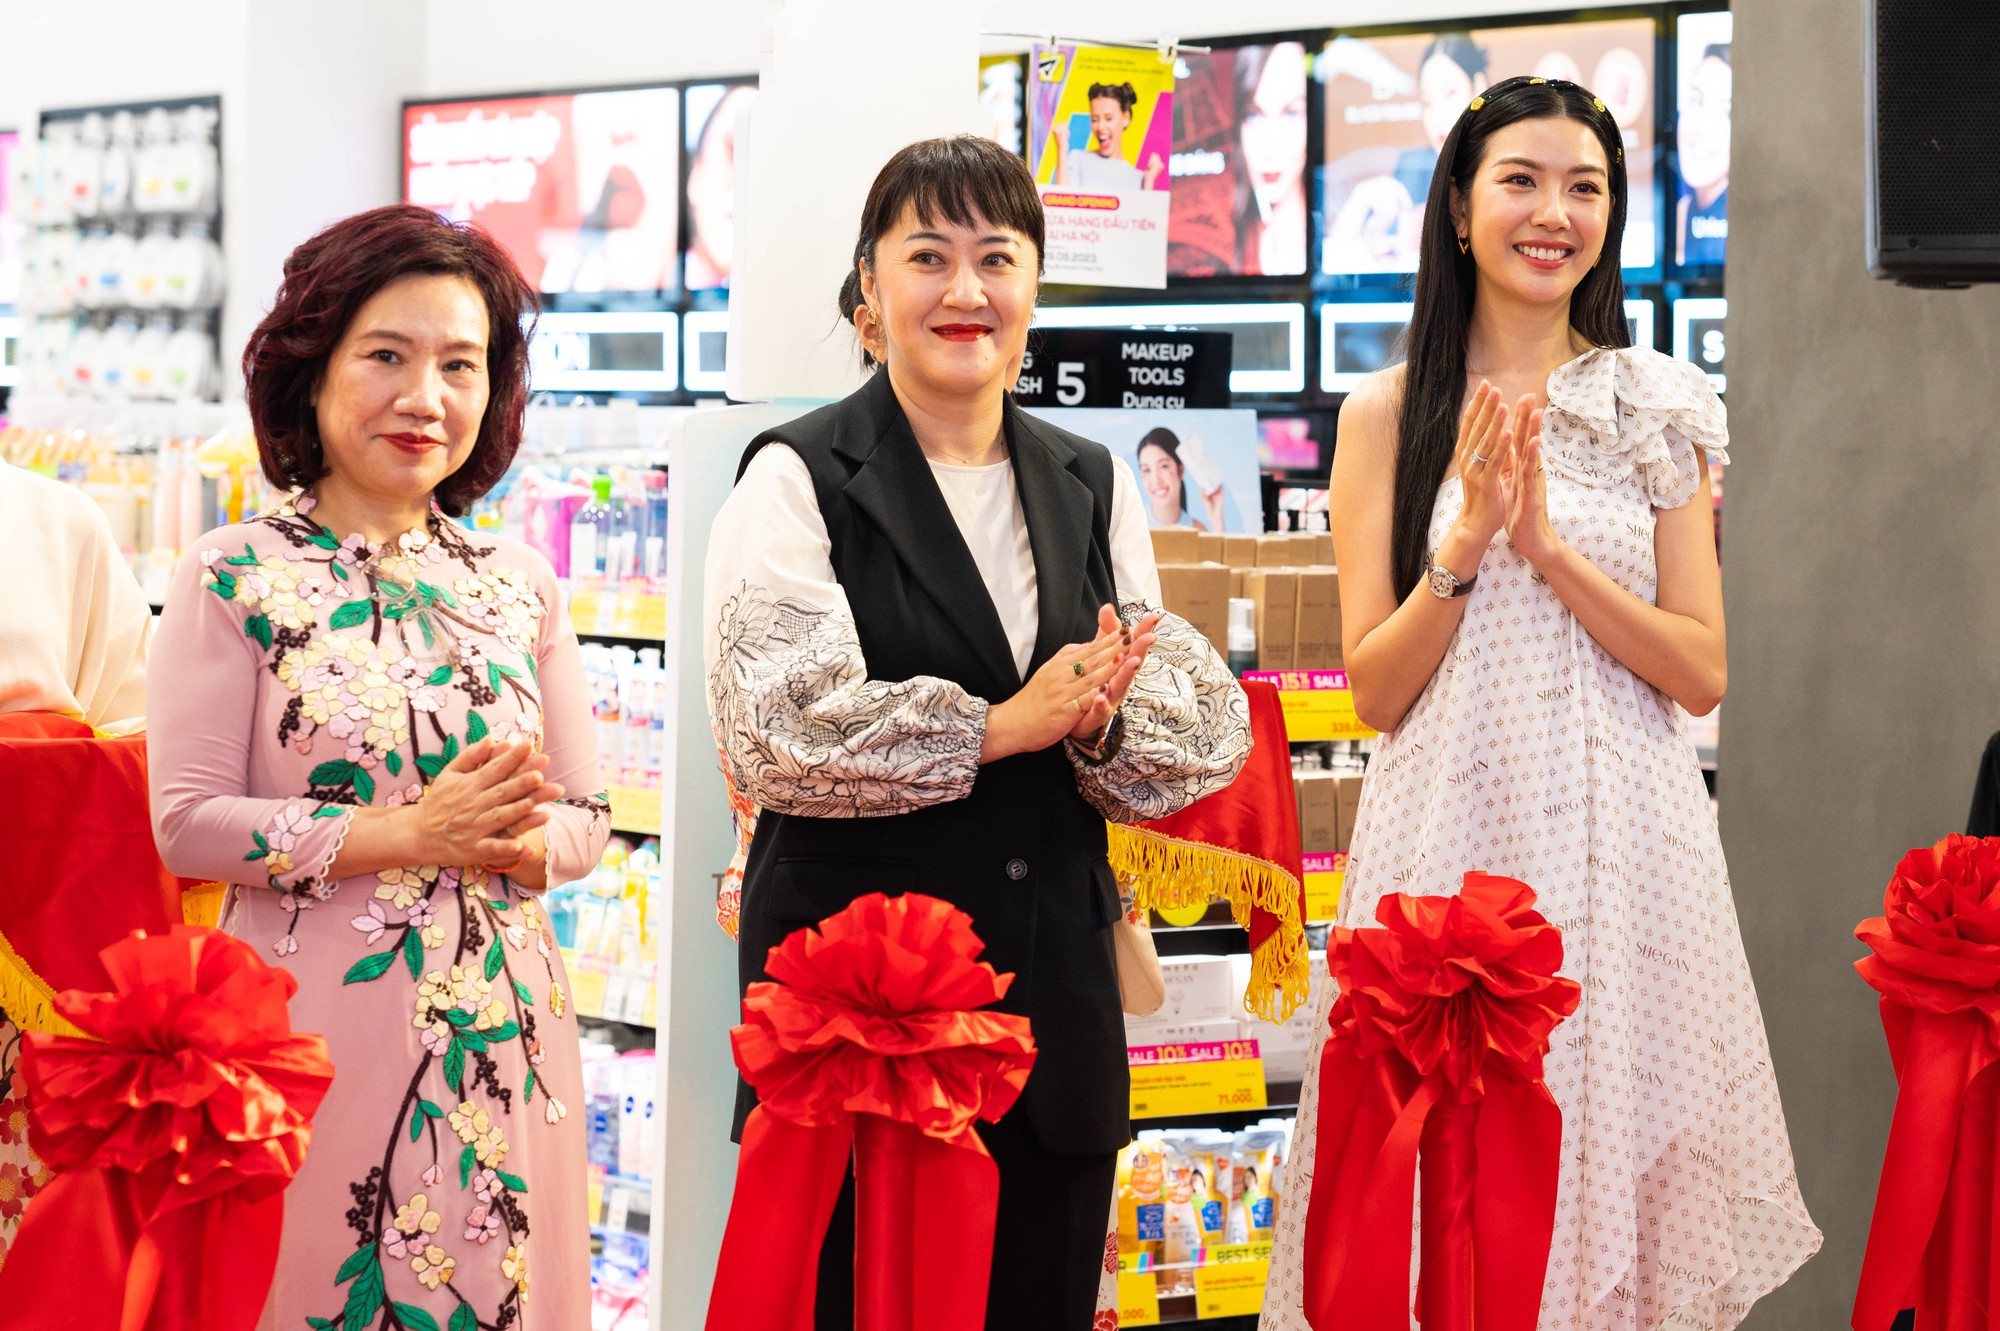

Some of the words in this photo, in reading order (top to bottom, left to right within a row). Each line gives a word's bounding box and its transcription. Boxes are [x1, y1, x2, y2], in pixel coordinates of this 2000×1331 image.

[1077, 195, 1119, 209] OPENING
[1121, 343, 1194, 361] MAKEUP
[1056, 361, 1086, 406] 5
[1128, 367, 1185, 386] TOOLS
[1313, 674, 1344, 688] SALE
[1301, 857, 1332, 871] SALE
[1127, 1050, 1155, 1063] SALE
[1156, 1045, 1187, 1064] 10%
[1190, 1046, 1222, 1059] SALE
[1223, 1040, 1253, 1060] 10%
[1217, 1249, 1249, 1264] BEST
